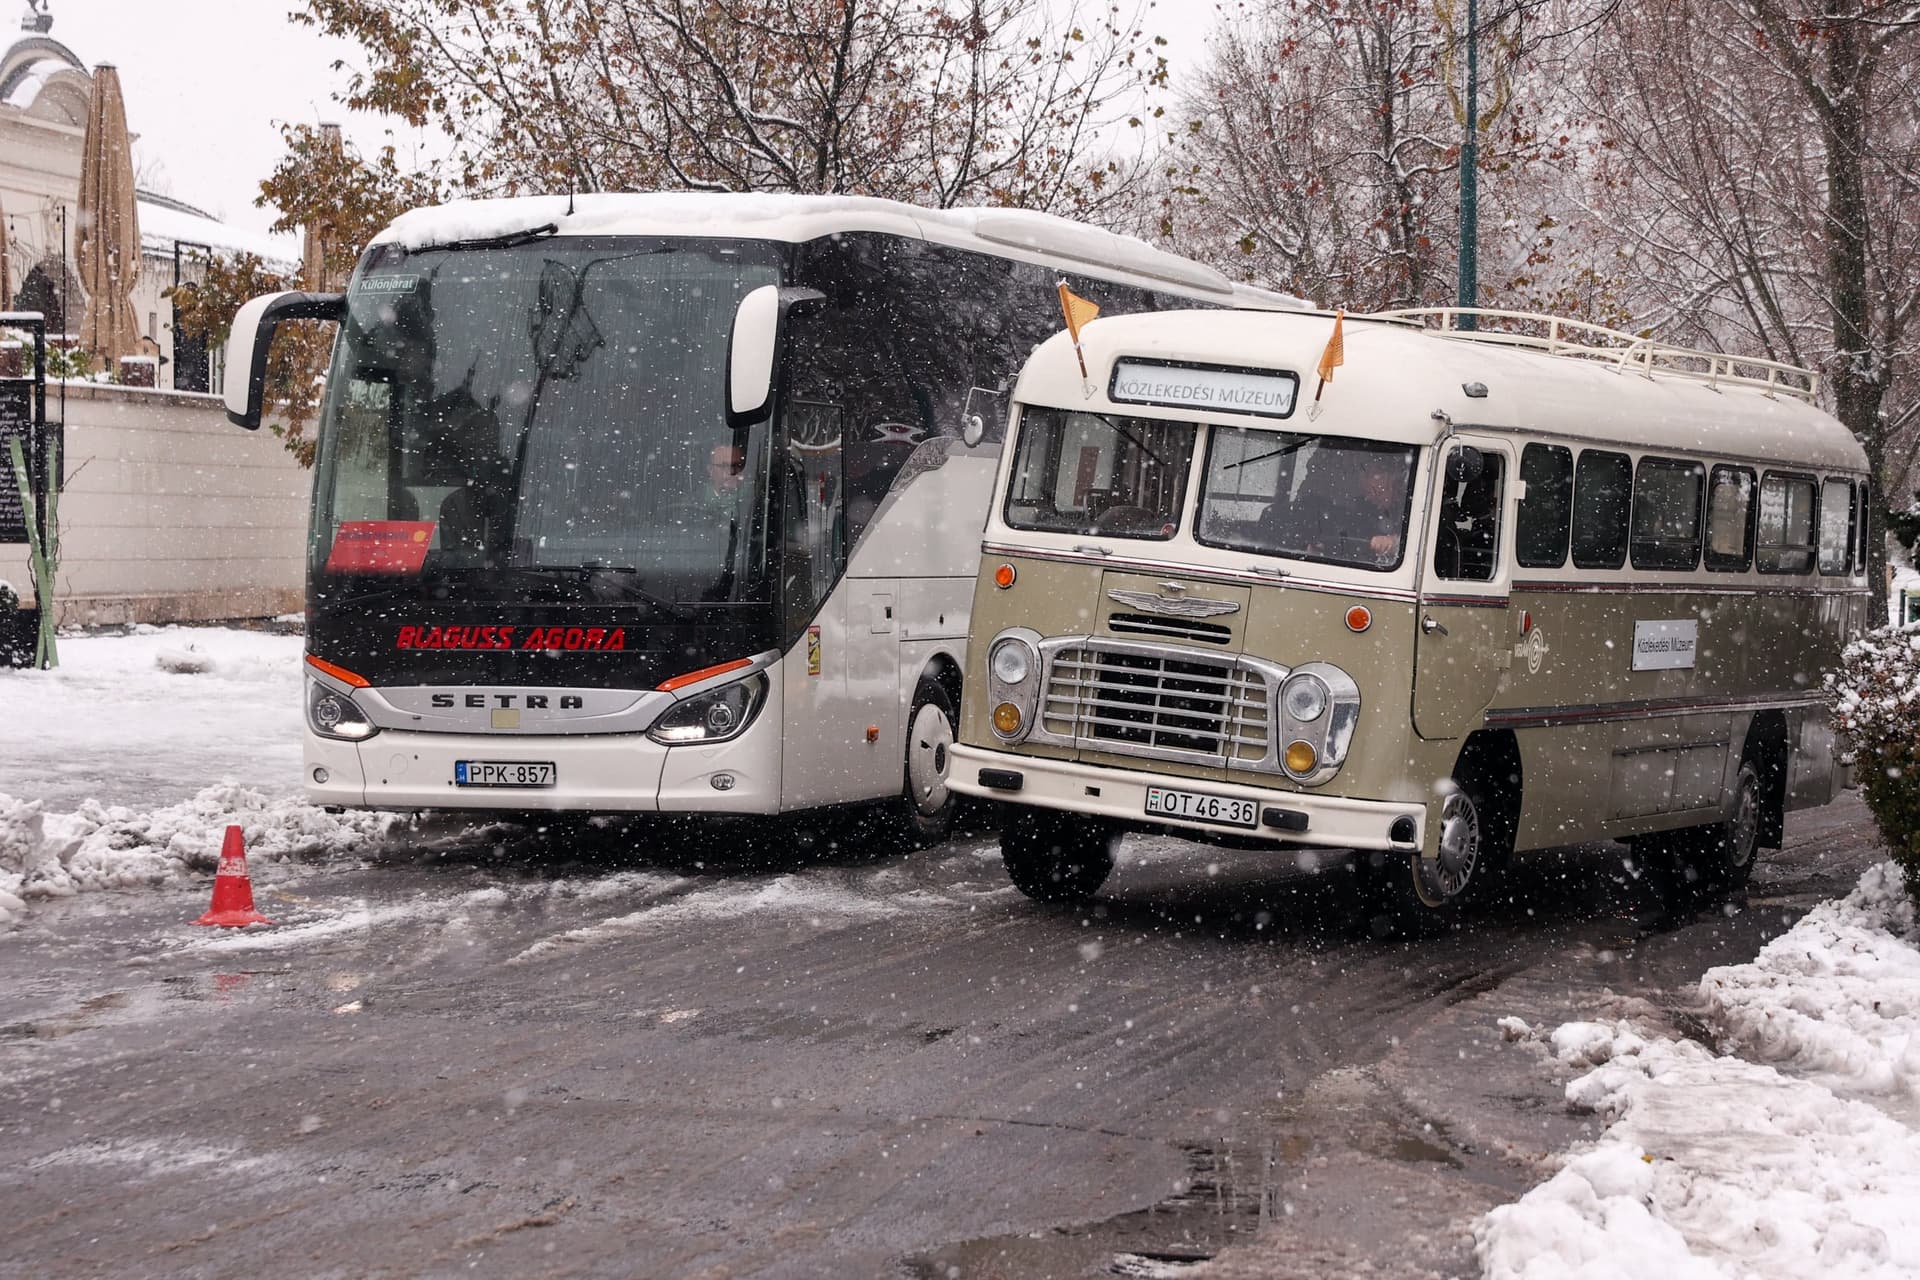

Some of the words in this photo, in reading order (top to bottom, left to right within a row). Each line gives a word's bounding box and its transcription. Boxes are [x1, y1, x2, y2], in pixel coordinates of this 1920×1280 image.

[1119, 380, 1214, 401] KÖZLEKEDÉSI
[1218, 388, 1291, 408] MÚZEUM
[397, 626, 515, 649] BLAGUSS
[521, 627, 625, 651] AGORA
[431, 694, 583, 709] SETRA
[470, 766, 549, 783] PPK-857
